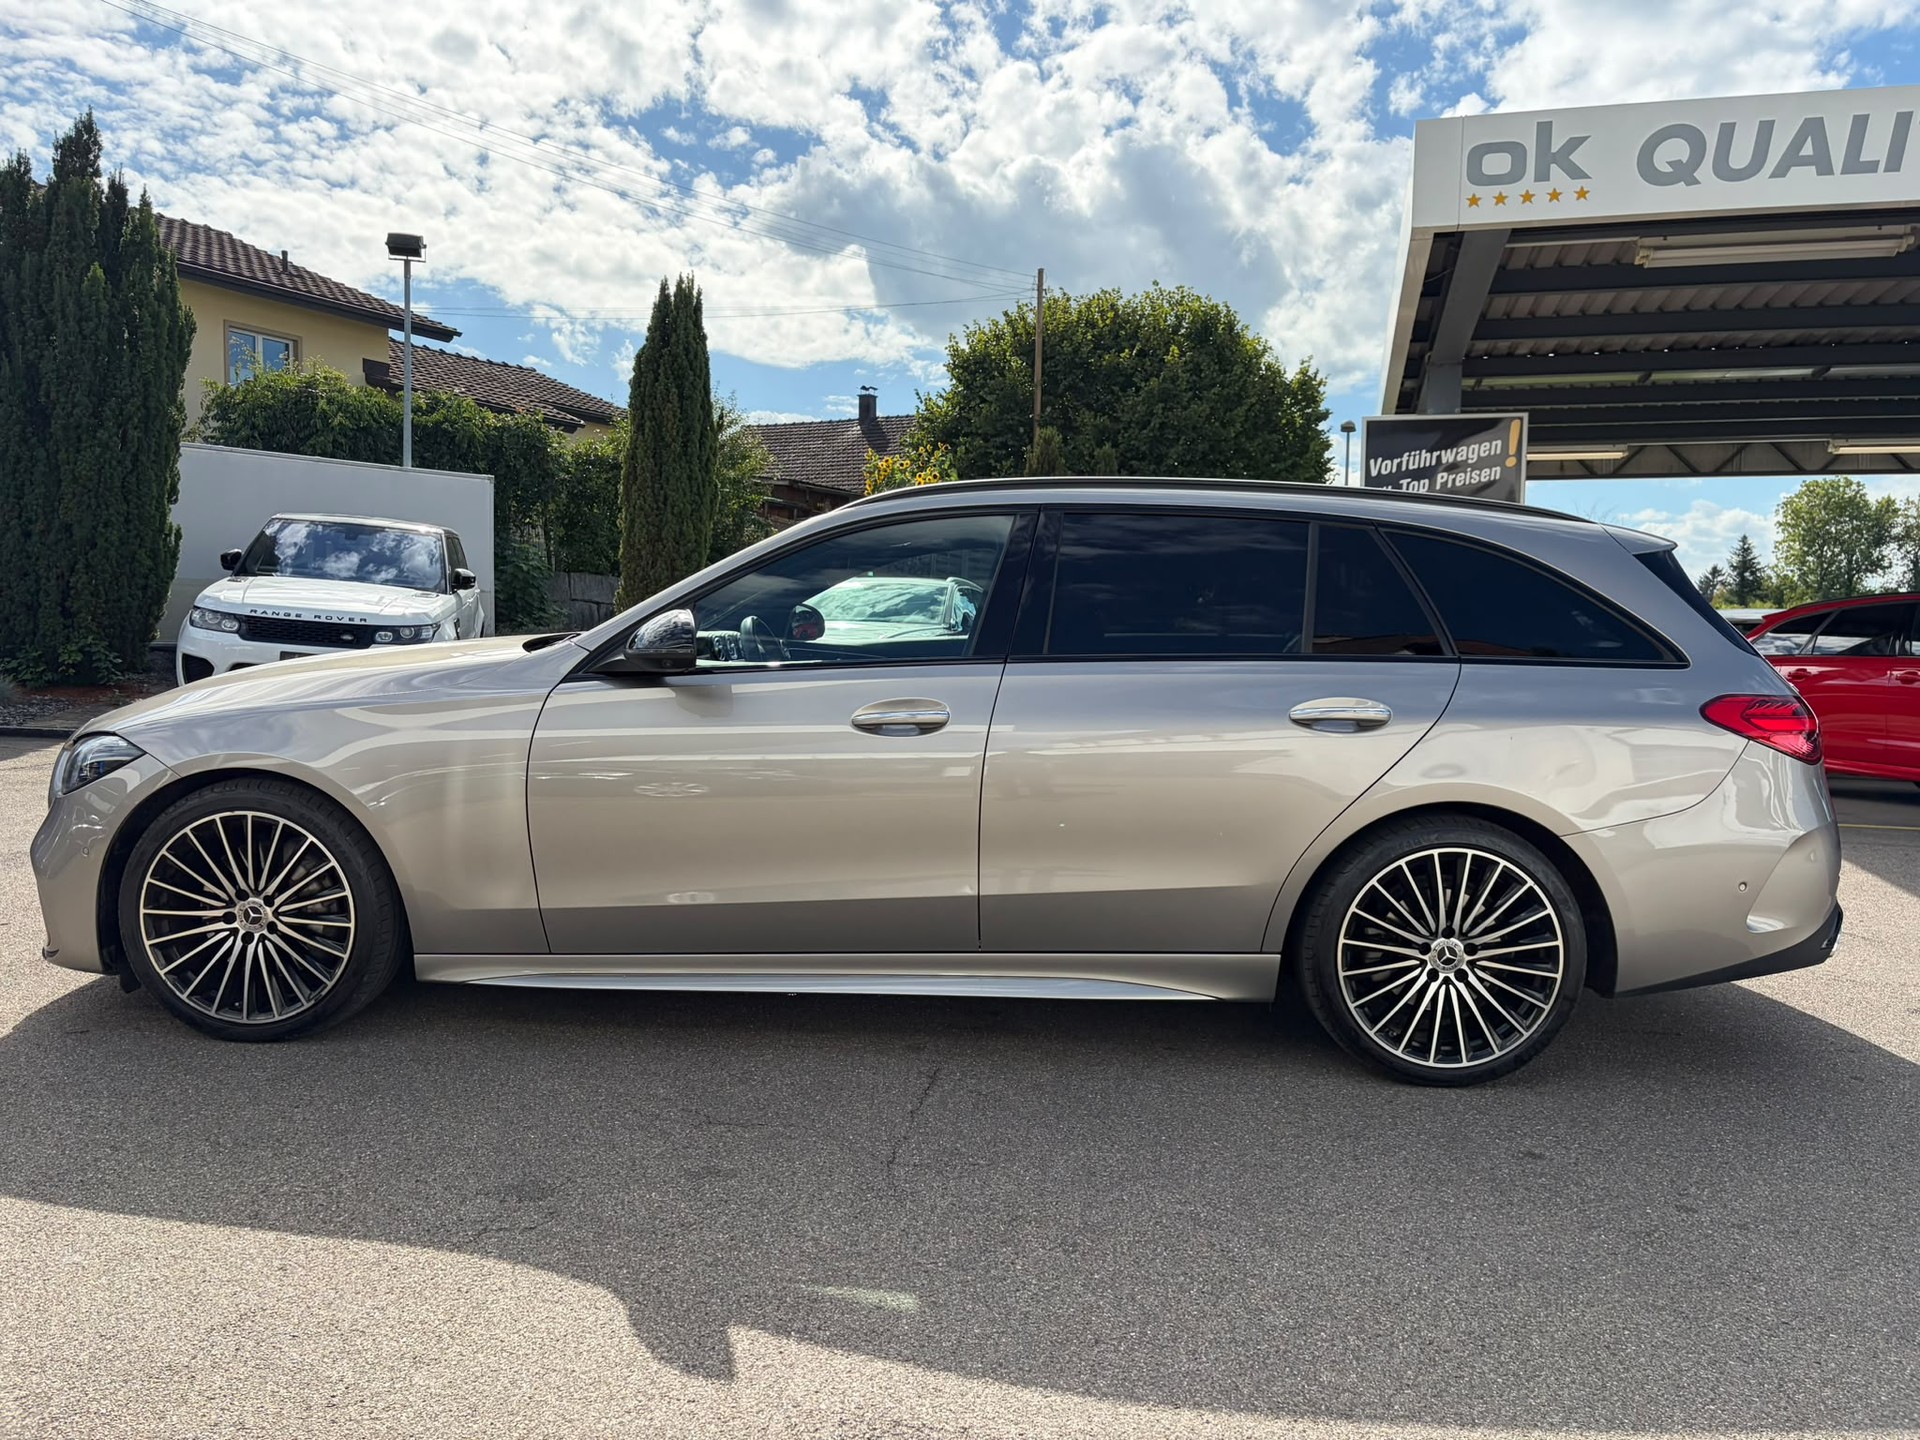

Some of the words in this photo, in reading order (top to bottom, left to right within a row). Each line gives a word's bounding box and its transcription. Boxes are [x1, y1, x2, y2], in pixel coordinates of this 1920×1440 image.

[1466, 120, 1592, 187] ok
[1636, 111, 1920, 187] QUALI
[1369, 439, 1502, 477] Vorführwagen
[1399, 478, 1430, 493] Top
[1435, 466, 1501, 490] Preisen
[249, 609, 303, 618] RANGE
[313, 614, 368, 623] ROVER
